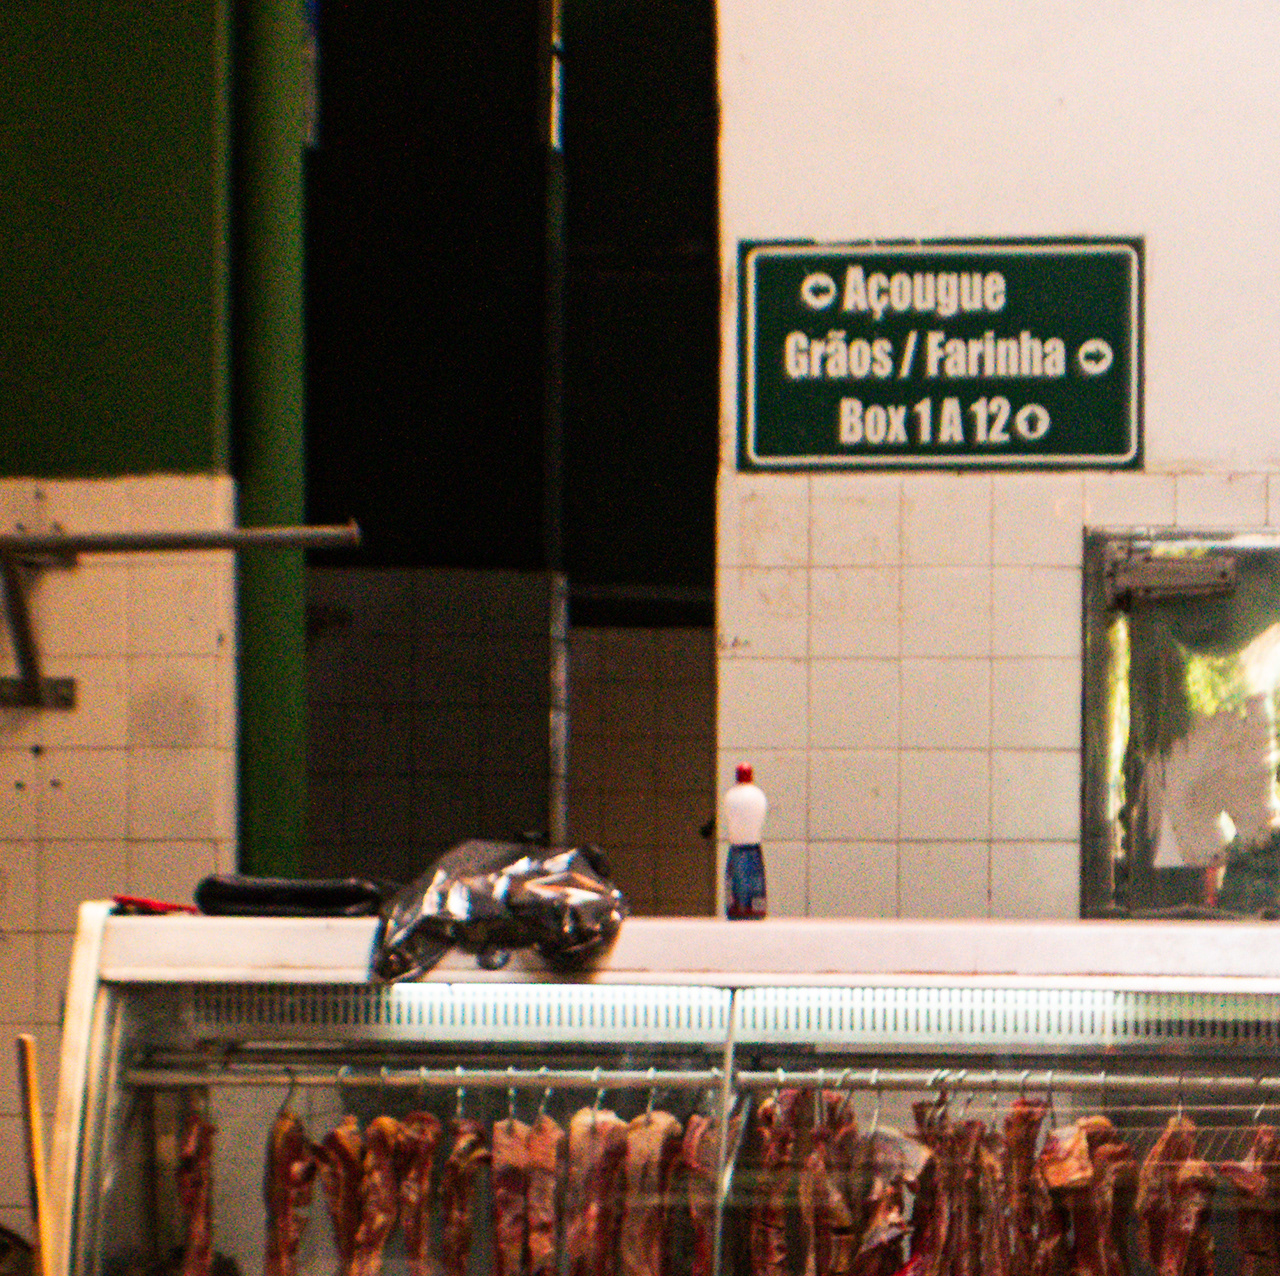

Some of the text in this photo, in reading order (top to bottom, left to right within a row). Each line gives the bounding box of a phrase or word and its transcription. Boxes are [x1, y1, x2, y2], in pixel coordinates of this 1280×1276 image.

[841, 264, 1007, 320] Açougue
[783, 329, 1067, 379] Grãos / Farinha
[838, 395, 1012, 445] Box 1 A 12
